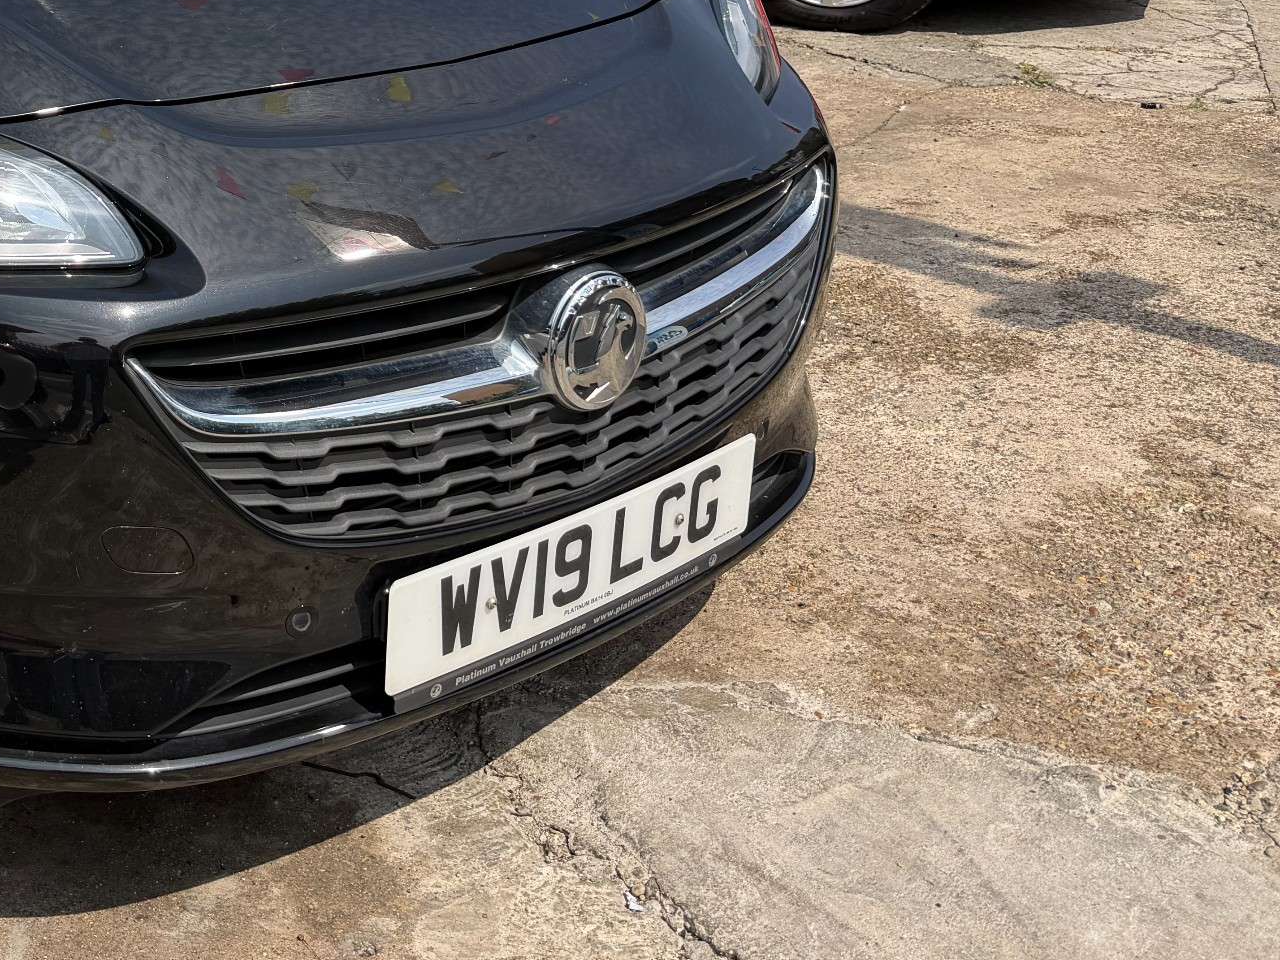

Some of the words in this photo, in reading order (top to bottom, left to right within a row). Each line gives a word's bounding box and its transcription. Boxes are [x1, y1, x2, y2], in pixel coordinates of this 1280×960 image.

[440, 524, 593, 657] WV19
[609, 464, 722, 585] LCG
[455, 663, 497, 687] Platinum
[498, 643, 538, 668] Vauxhall
[539, 622, 587, 652] Trowbridge
[592, 565, 700, 625] www.platinumvauxhall.co.uk
